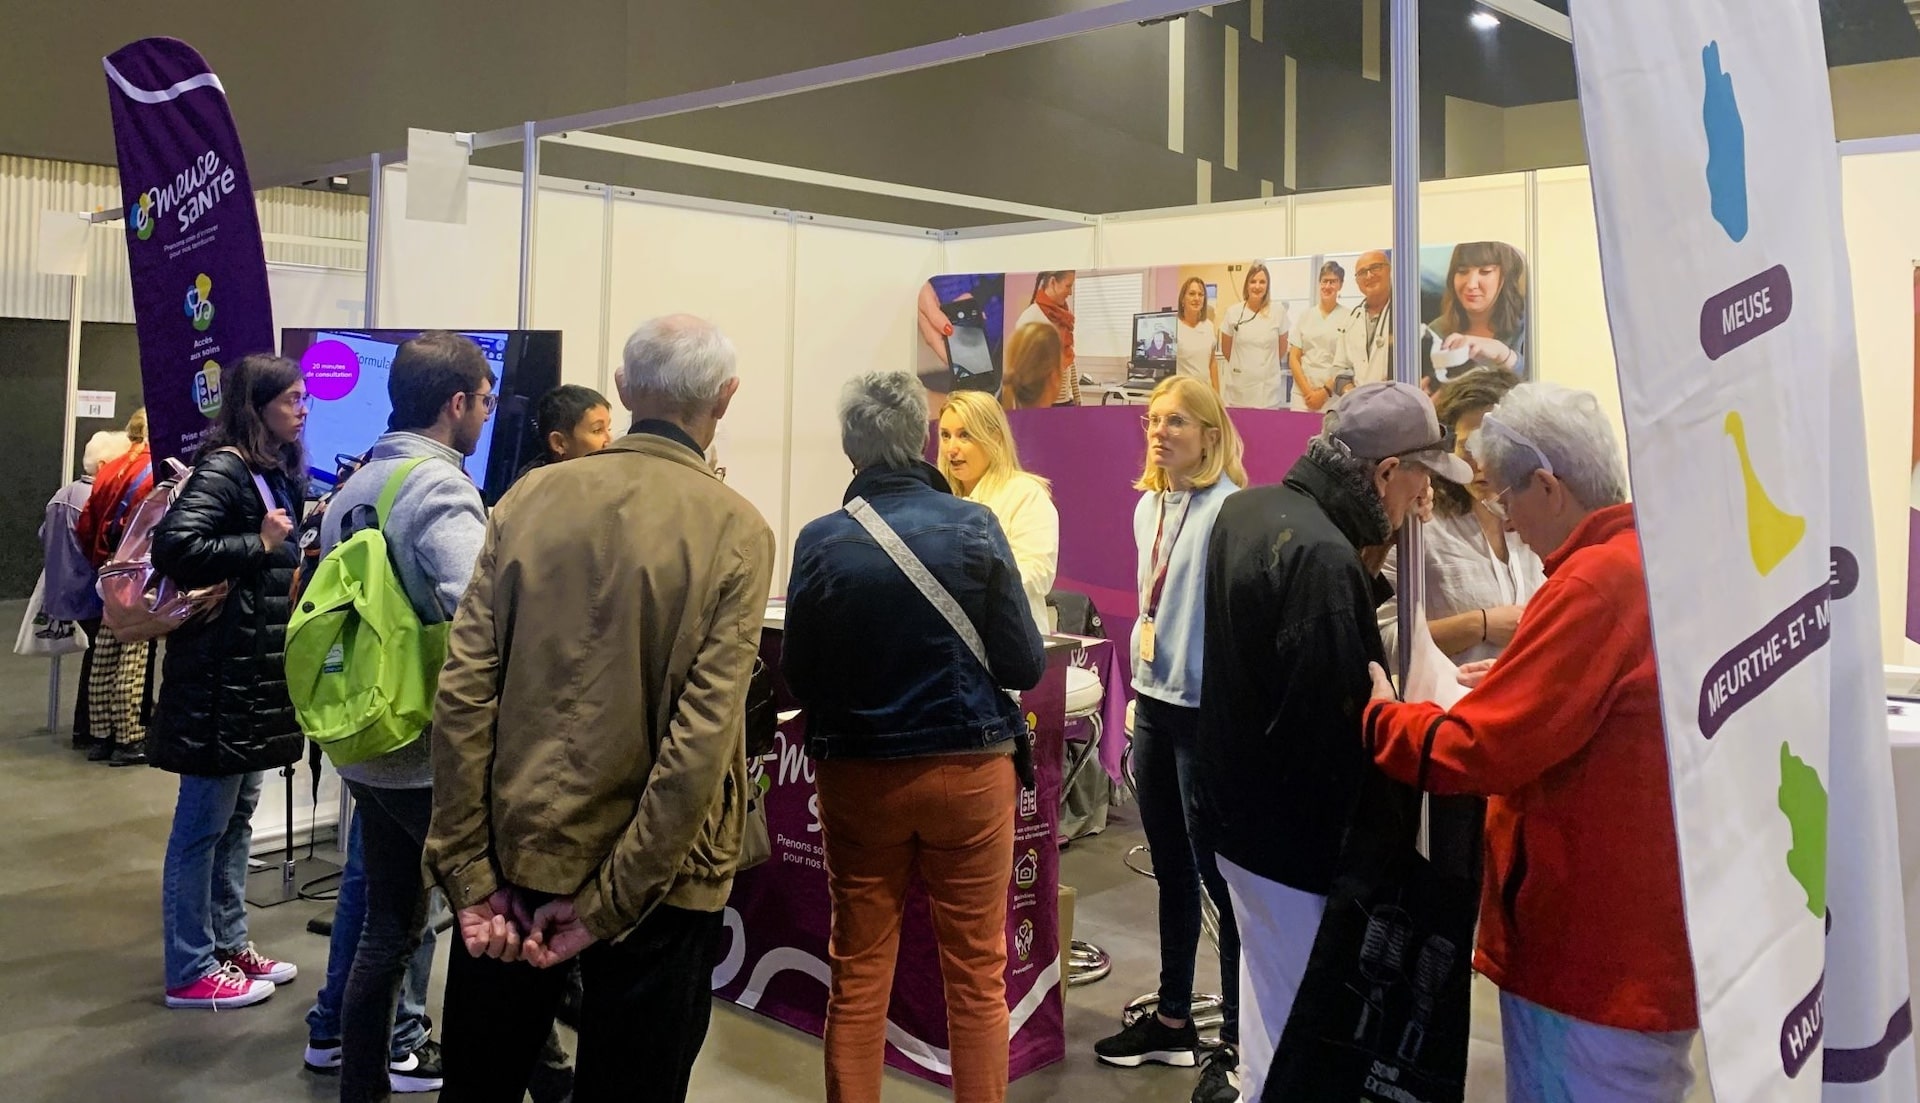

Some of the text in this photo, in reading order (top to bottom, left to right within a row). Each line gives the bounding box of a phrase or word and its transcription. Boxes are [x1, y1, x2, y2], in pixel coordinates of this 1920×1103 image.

[1722, 286, 1772, 335] MEUSE
[193, 336, 213, 348] Accès
[190, 345, 220, 360] aux soins
[181, 431, 198, 443] Prise
[777, 833, 824, 856] Prenons so
[783, 852, 803, 863] pour
[805, 857, 821, 869] nos
